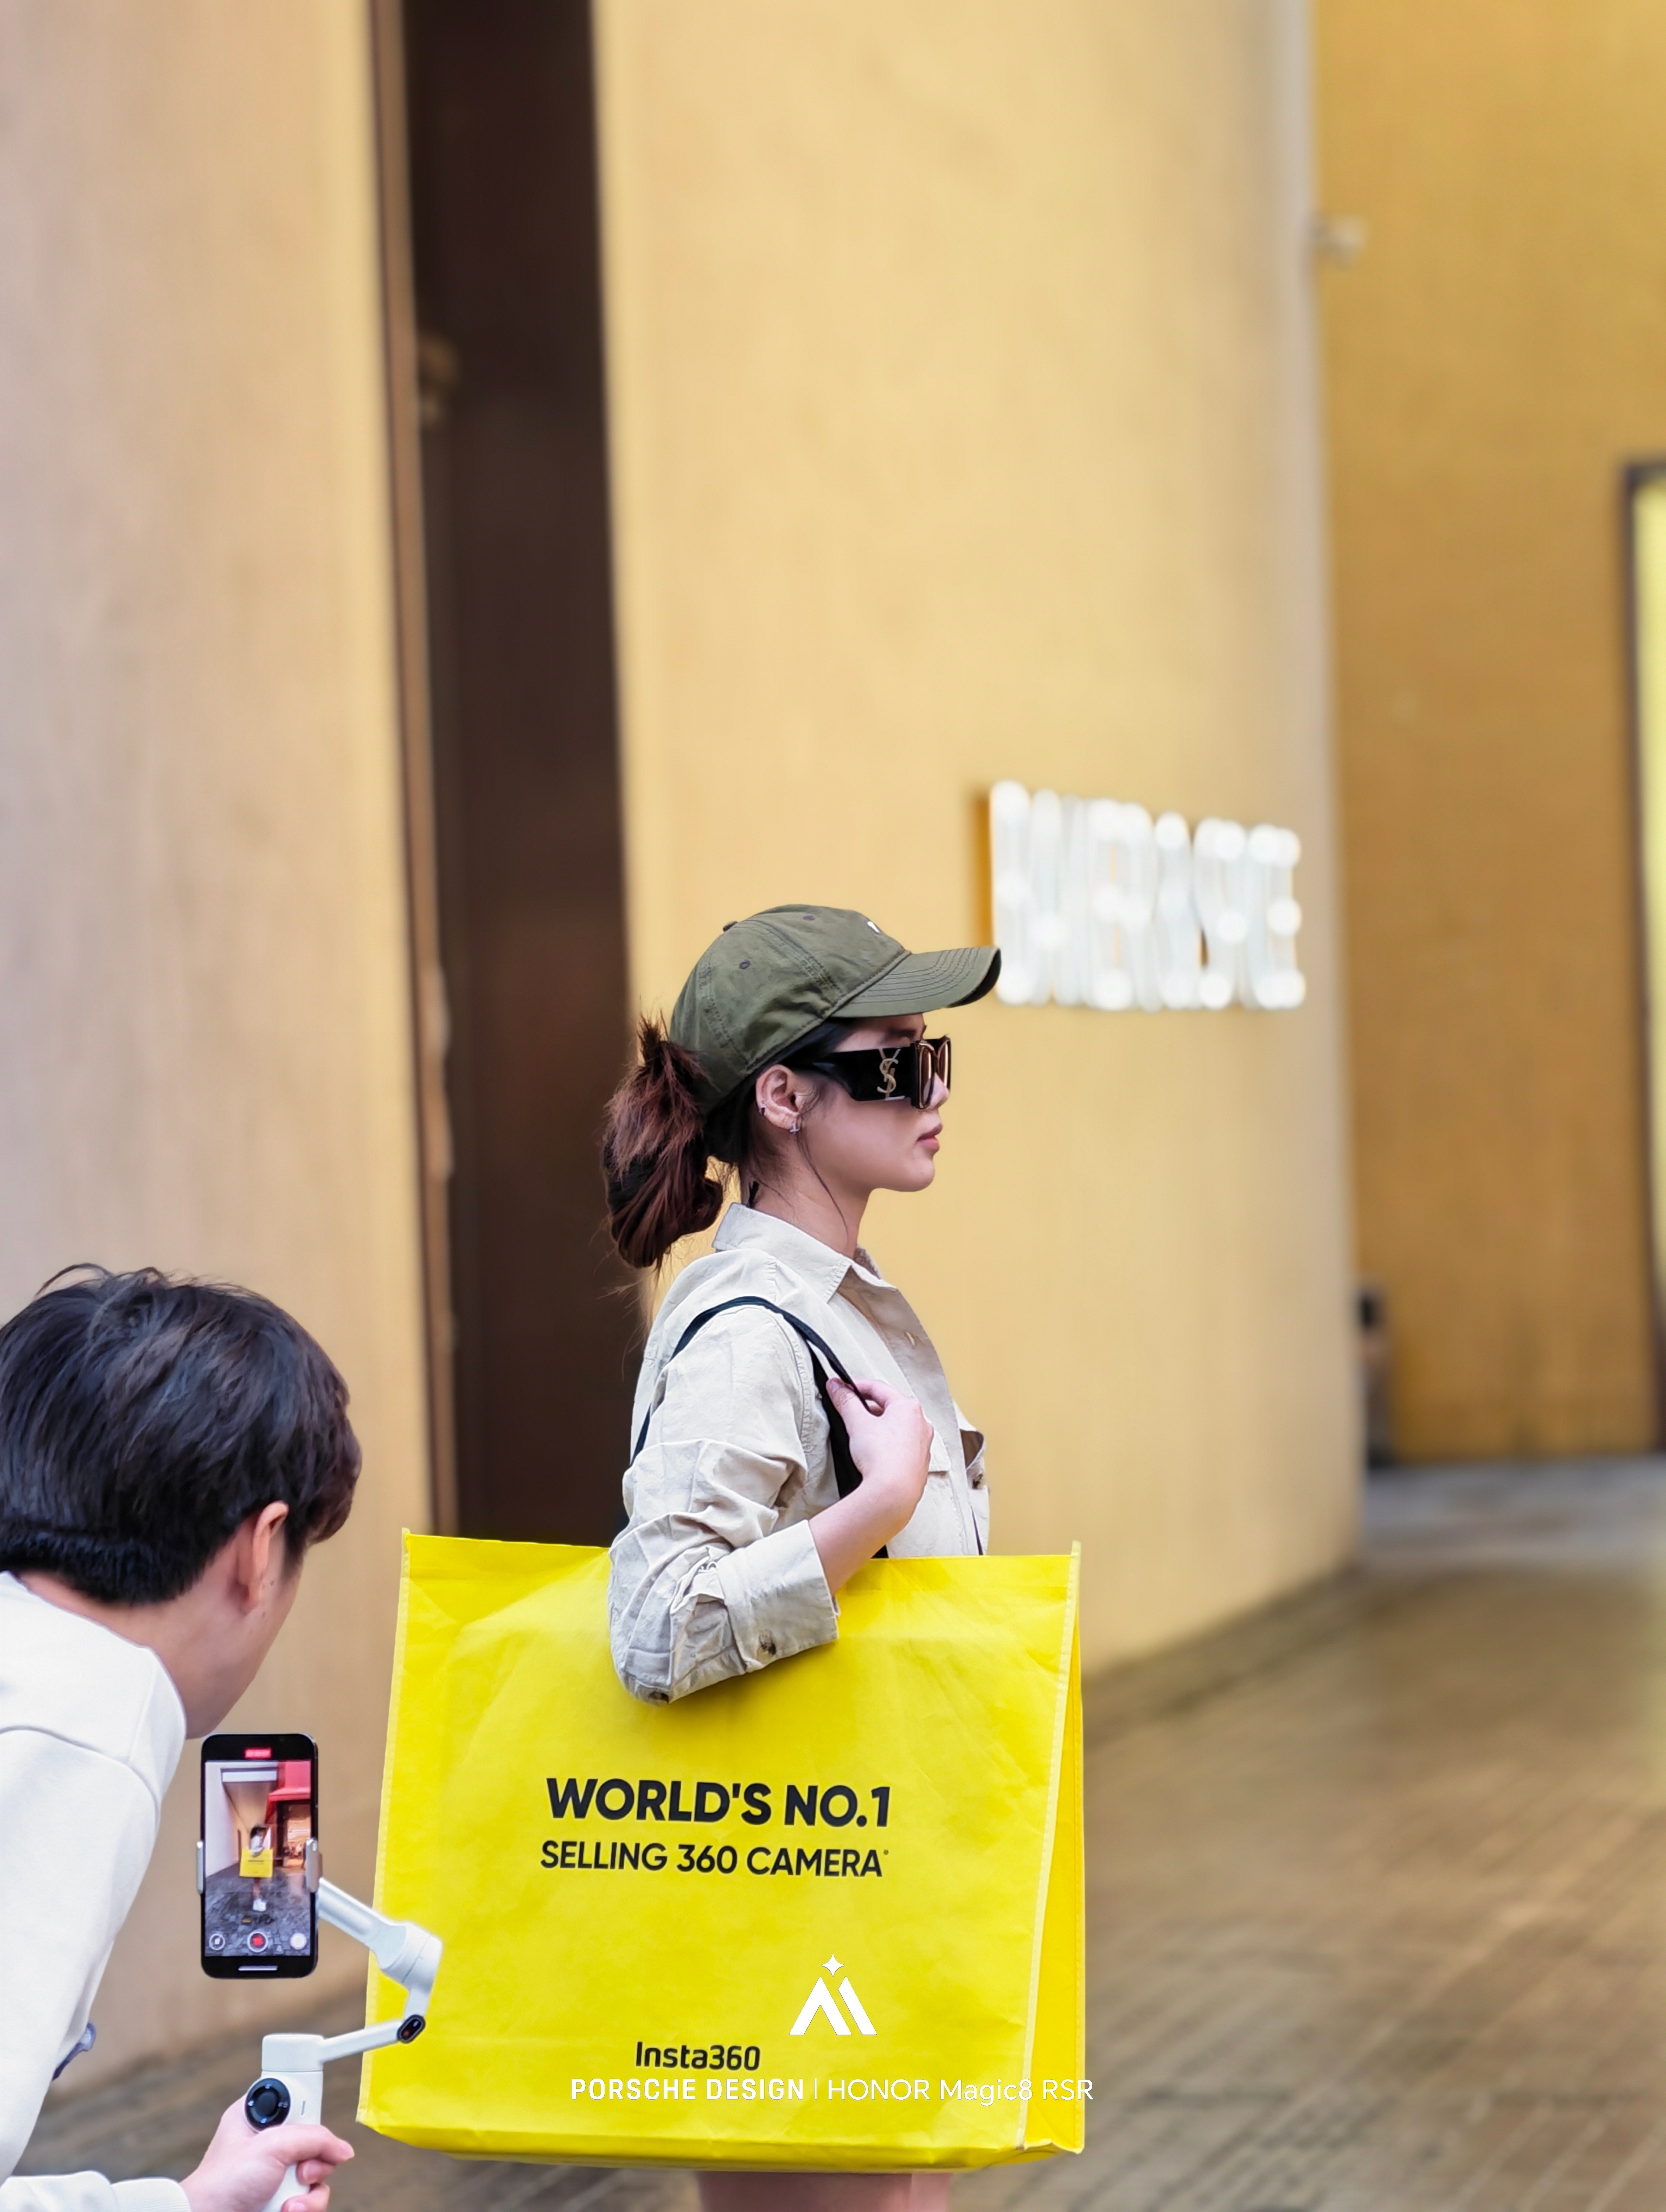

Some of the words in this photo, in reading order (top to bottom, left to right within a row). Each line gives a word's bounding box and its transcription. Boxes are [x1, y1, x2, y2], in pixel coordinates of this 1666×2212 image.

[546, 1777, 772, 1826] WORLD'S
[784, 1784, 891, 1828] NO.1
[540, 1840, 668, 1871] SELLING
[676, 1843, 738, 1874] 360
[635, 2041, 761, 2072] Insta360
